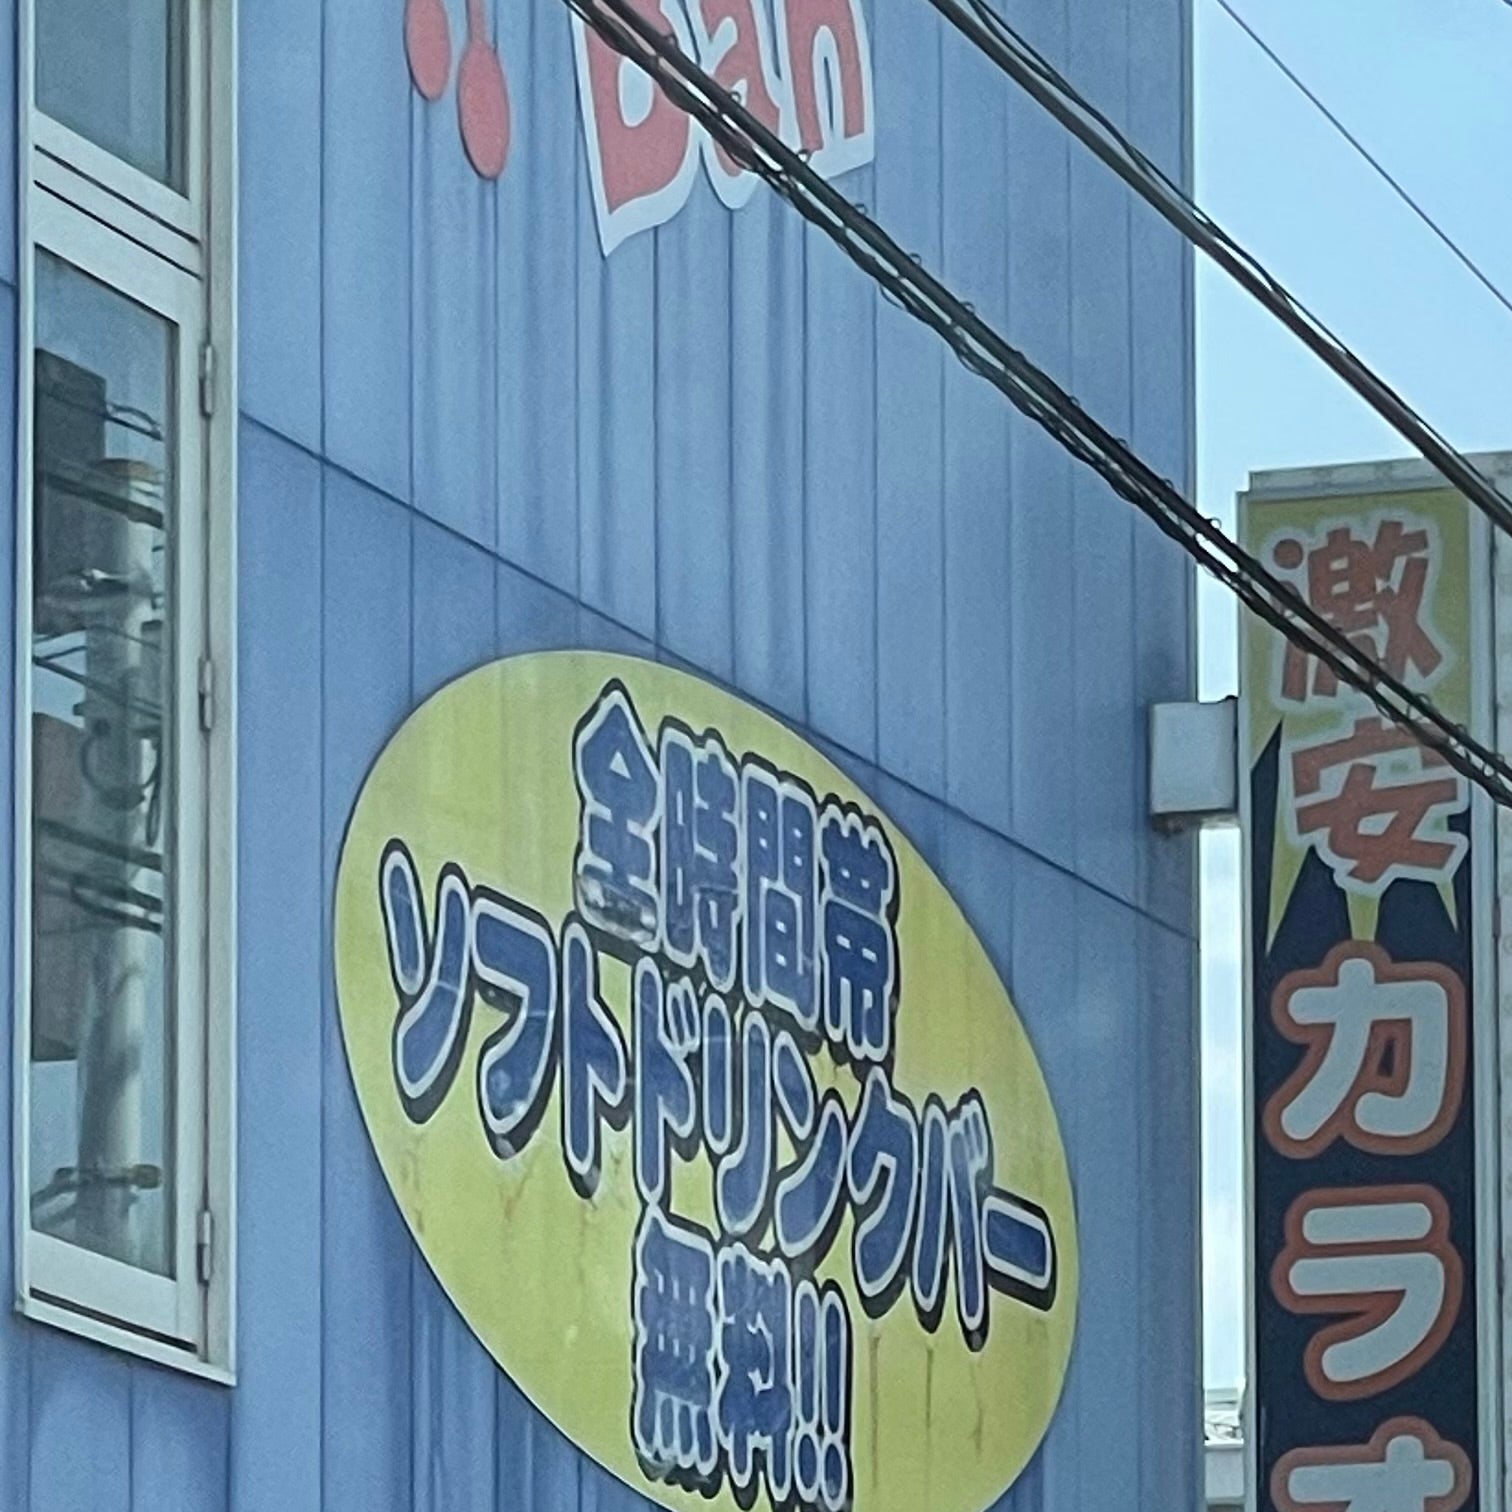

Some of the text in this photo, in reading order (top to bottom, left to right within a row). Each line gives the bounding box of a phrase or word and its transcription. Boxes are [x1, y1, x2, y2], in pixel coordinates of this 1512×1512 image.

[382, 840, 1054, 1348] ソフトドリンクバー
[575, 685, 895, 1066] 全時間帯
